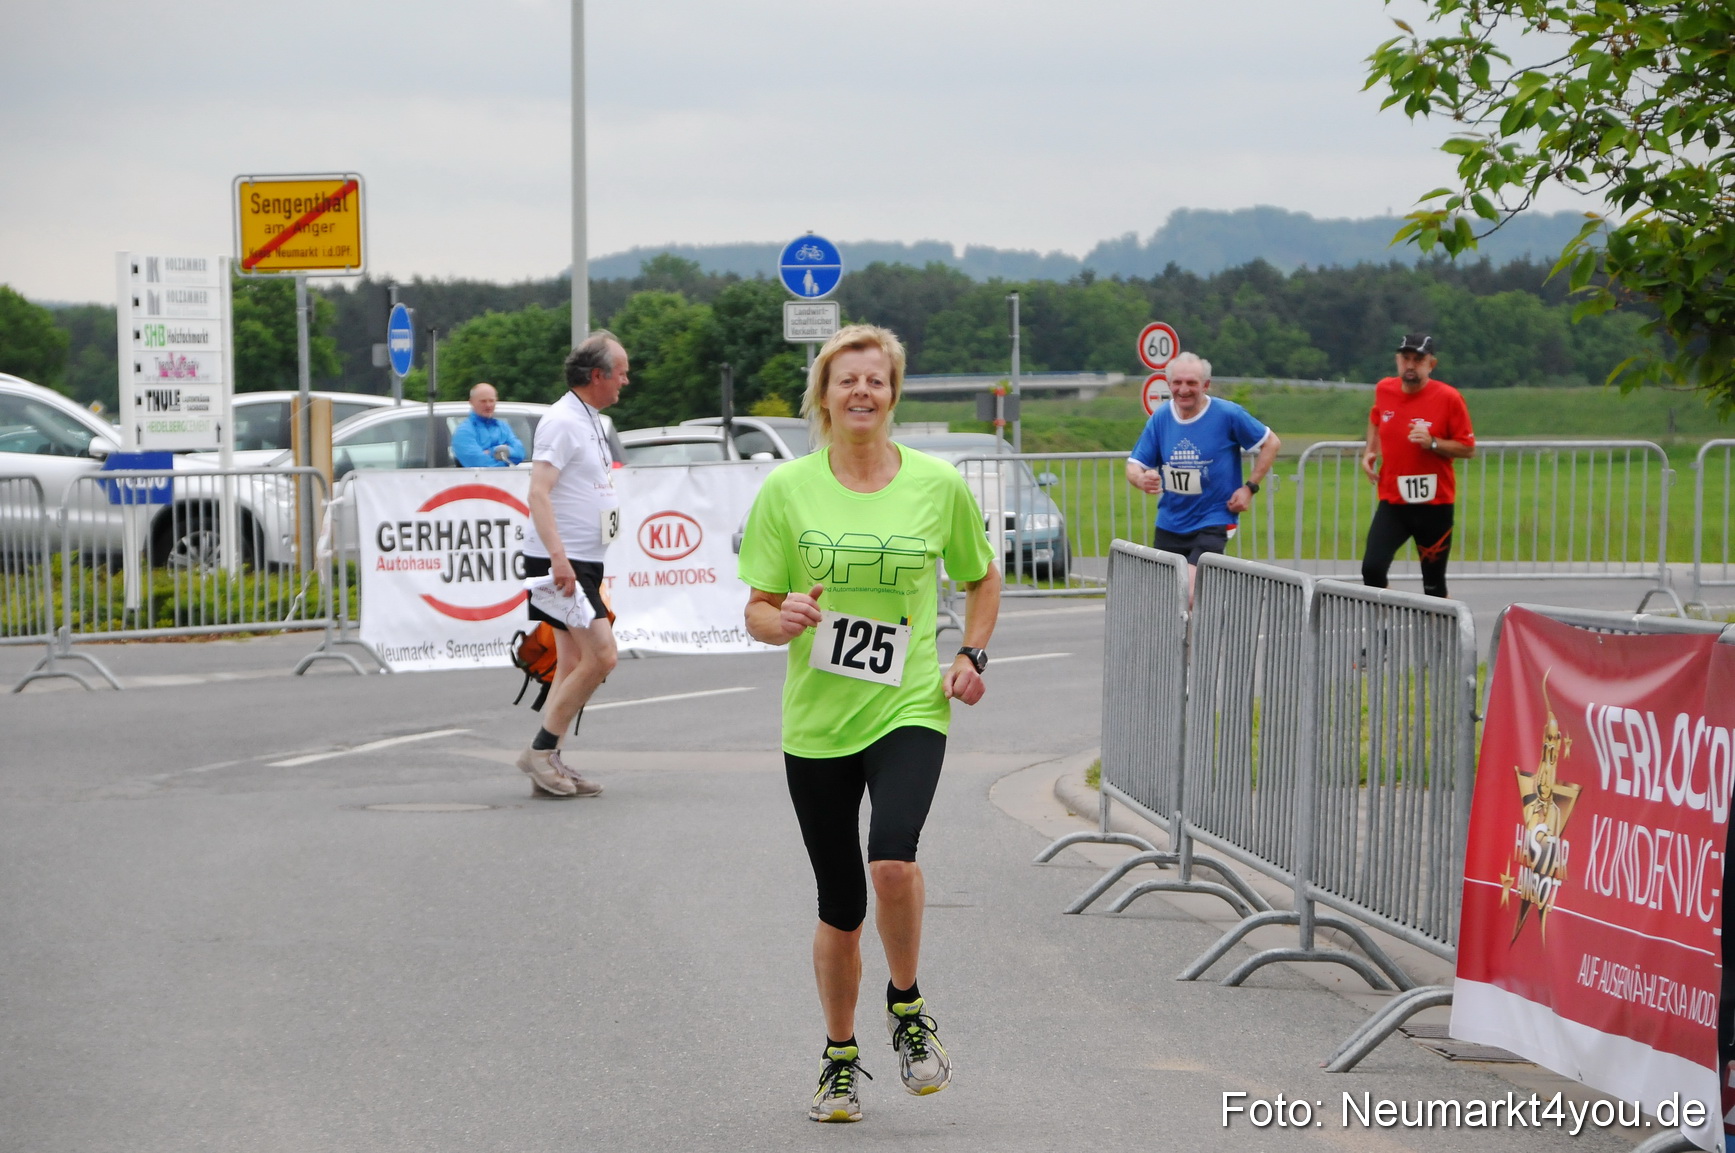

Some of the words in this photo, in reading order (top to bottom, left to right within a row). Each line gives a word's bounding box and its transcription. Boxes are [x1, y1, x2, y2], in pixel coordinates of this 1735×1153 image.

[251, 191, 348, 219] Sengenthal
[293, 222, 335, 237] Anger
[275, 246, 318, 258] Neumarkt
[144, 323, 166, 347] SHB
[1148, 336, 1170, 357] 60
[145, 389, 180, 412] THULE
[1170, 470, 1190, 491] 117
[1405, 477, 1429, 498] 115
[375, 518, 511, 552] GERHART
[514, 525, 524, 540] &
[649, 522, 690, 549] KIA
[375, 555, 442, 572] Autohaus
[628, 571, 650, 588] KIA
[654, 567, 717, 587] MOTORS
[831, 617, 897, 675] 125
[1577, 953, 1600, 988] AUF
